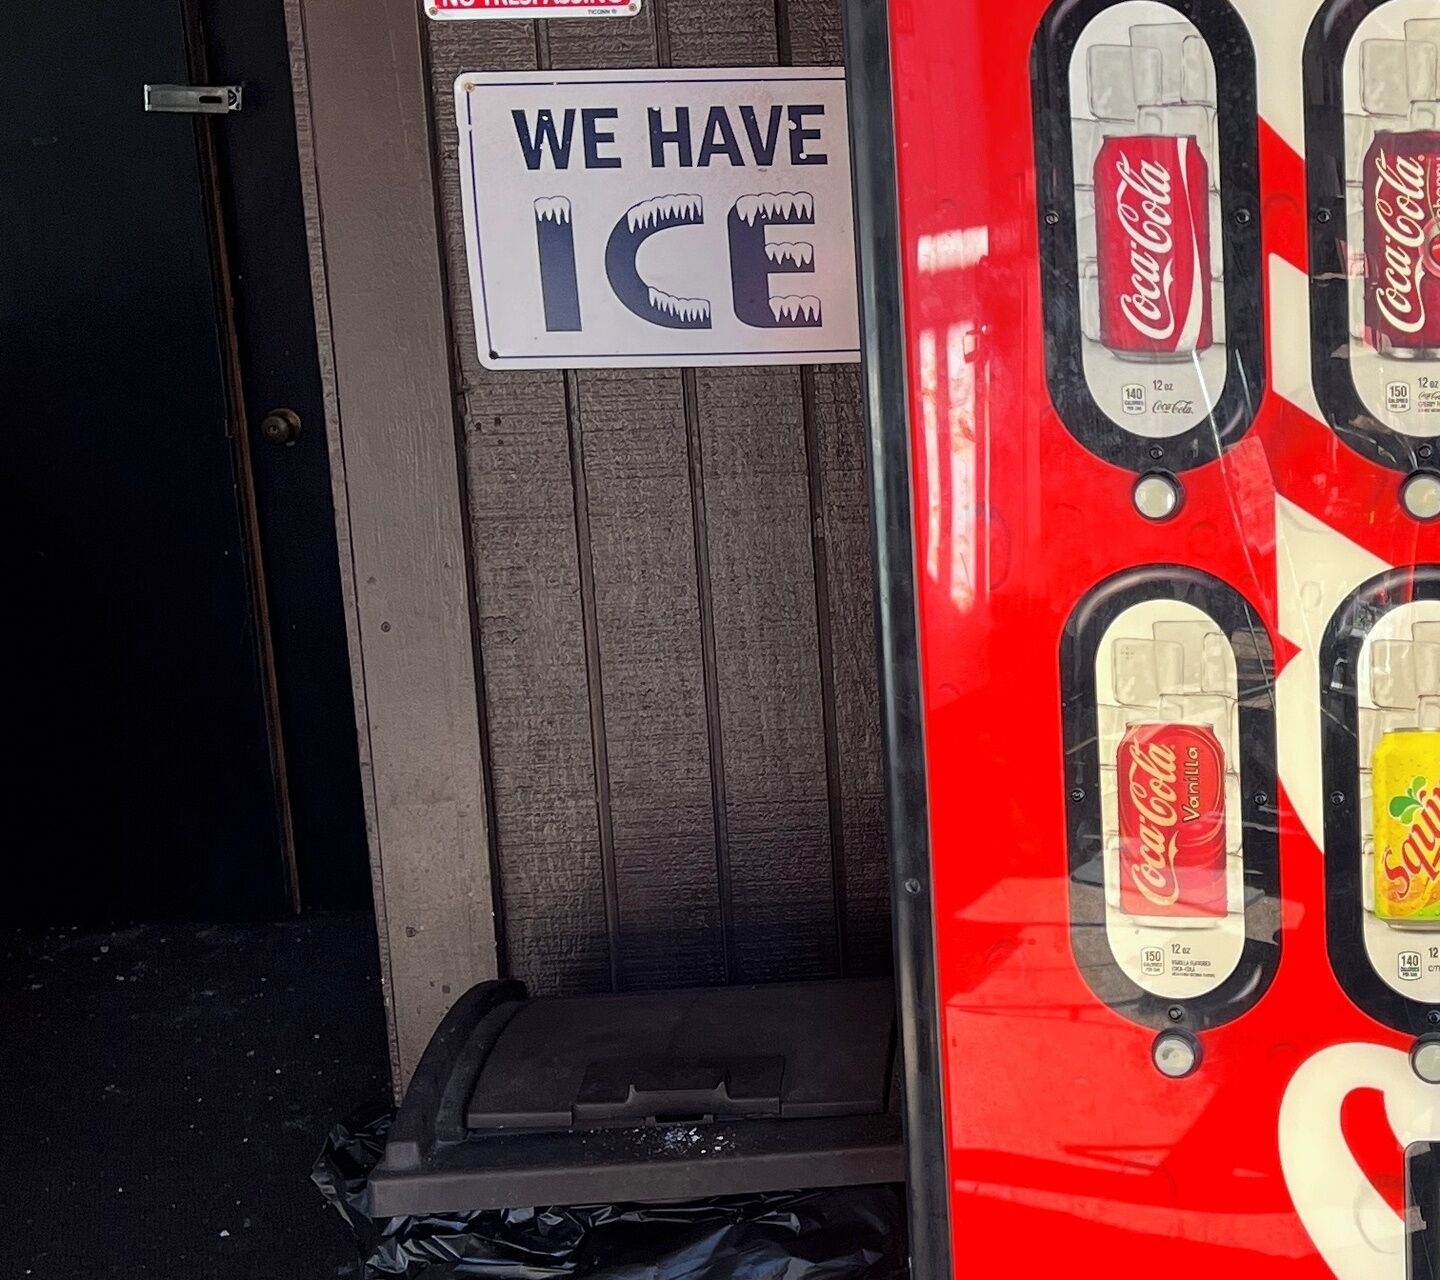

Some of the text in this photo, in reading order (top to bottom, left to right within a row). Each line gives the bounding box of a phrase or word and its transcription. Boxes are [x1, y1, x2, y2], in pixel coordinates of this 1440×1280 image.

[512, 104, 828, 170] WE HAVE
[533, 191, 823, 332] ICE
[1153, 380, 1162, 390] 12
[1418, 377, 1428, 388] 12
[1126, 389, 1142, 399] 140
[1390, 386, 1407, 397] 150
[1183, 746, 1199, 822] Vanilla
[1171, 944, 1180, 954] 12
[1428, 947, 1438, 958] 12
[1145, 951, 1161, 961] 150
[1402, 955, 1418, 966] 140
